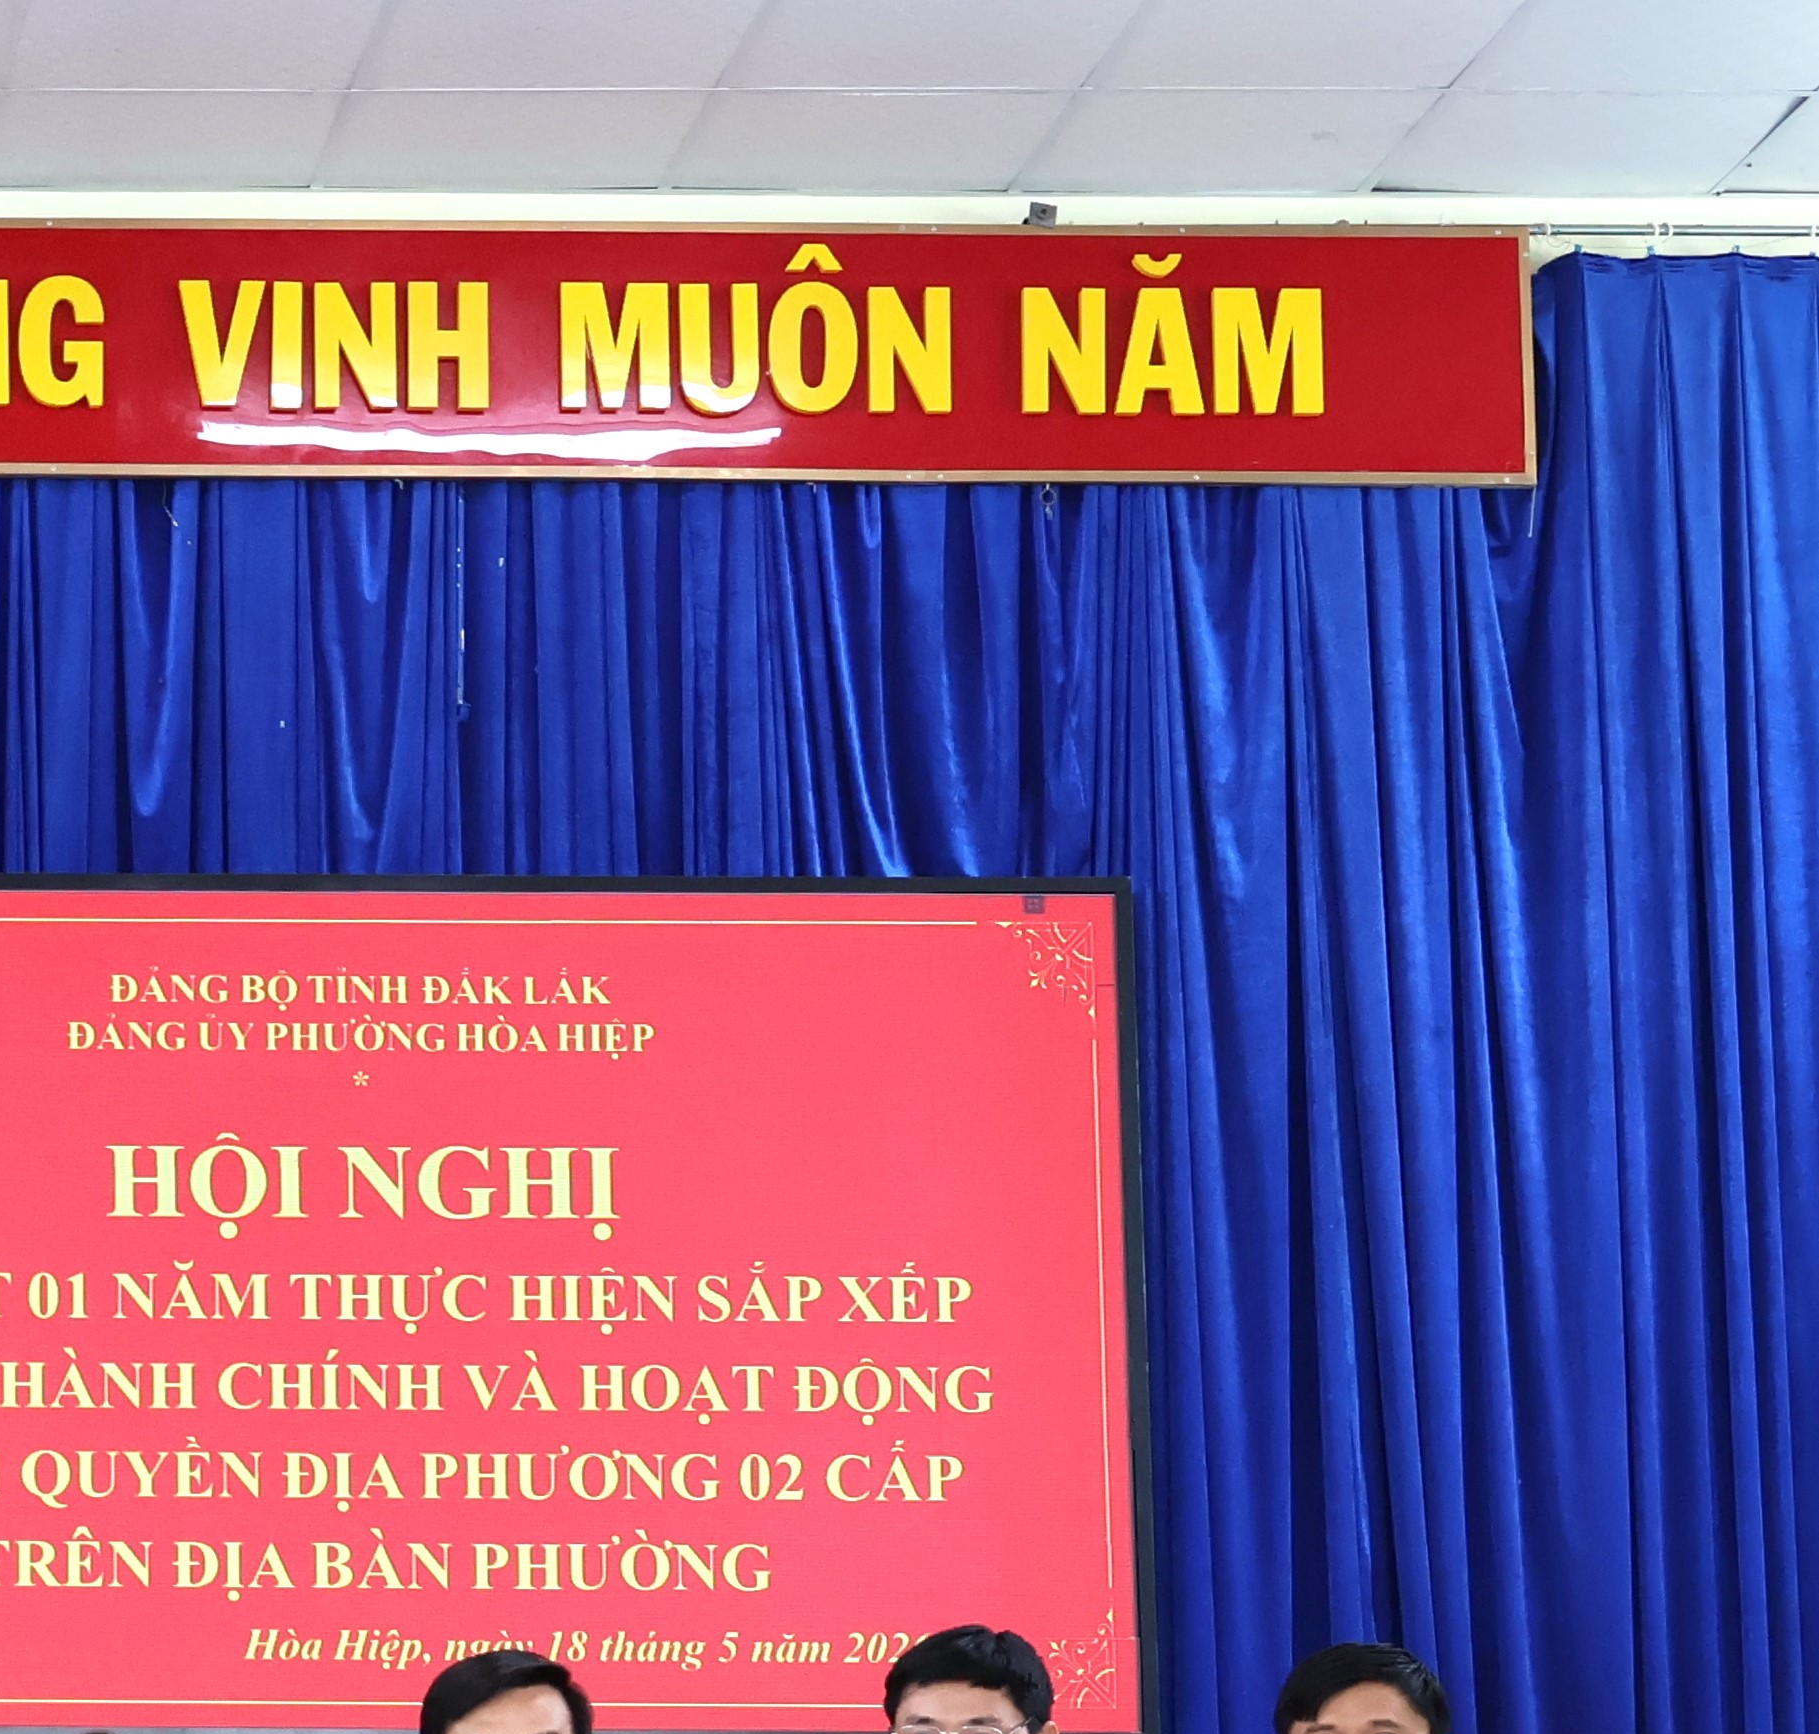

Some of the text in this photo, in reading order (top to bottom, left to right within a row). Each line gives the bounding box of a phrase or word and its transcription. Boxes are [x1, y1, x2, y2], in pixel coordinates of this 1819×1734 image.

[177, 280, 490, 412] VINH
[559, 243, 955, 416] MUÔN
[1020, 253, 1326, 416] NĂM
[68, 1013, 655, 1060] ĐẢNG ỦY PHƯỜNG HÒA HIỆP
[105, 1132, 621, 1241] HỘI NGHỊ
[28, 1272, 89, 1320] 01
[113, 1259, 271, 1320] NĂM
[290, 1266, 487, 1335] THỰC
[509, 1267, 678, 1336] HIỆN
[697, 1261, 823, 1323] SẮP
[837, 1261, 972, 1323] XẾP
[0, 1346, 198, 1410] HÀNH
[218, 1348, 445, 1411] CHÍNH
[463, 1350, 559, 1412] VÀ
[579, 1364, 775, 1426] HOẠT
[792, 1357, 995, 1427] ĐỘNG
[21, 1435, 263, 1509] QUYỀN
[282, 1451, 405, 1513] ĐỊA
[421, 1445, 721, 1502] PHƯƠNG
[739, 1454, 804, 1502] 02
[825, 1439, 964, 1502] CẤP
[172, 1541, 296, 1602] ĐỊA
[311, 1527, 453, 1590] BÀN
[470, 1529, 771, 1592] PHƯỜNG
[243, 1628, 323, 1661] Hòa
[333, 1628, 433, 1671] Hiệp,
[548, 1630, 589, 1662] 18
[599, 1630, 707, 1671] tháng
[717, 1631, 739, 1663] 5
[751, 1632, 831, 1664] năm
[843, 1631, 931, 1664] 202
